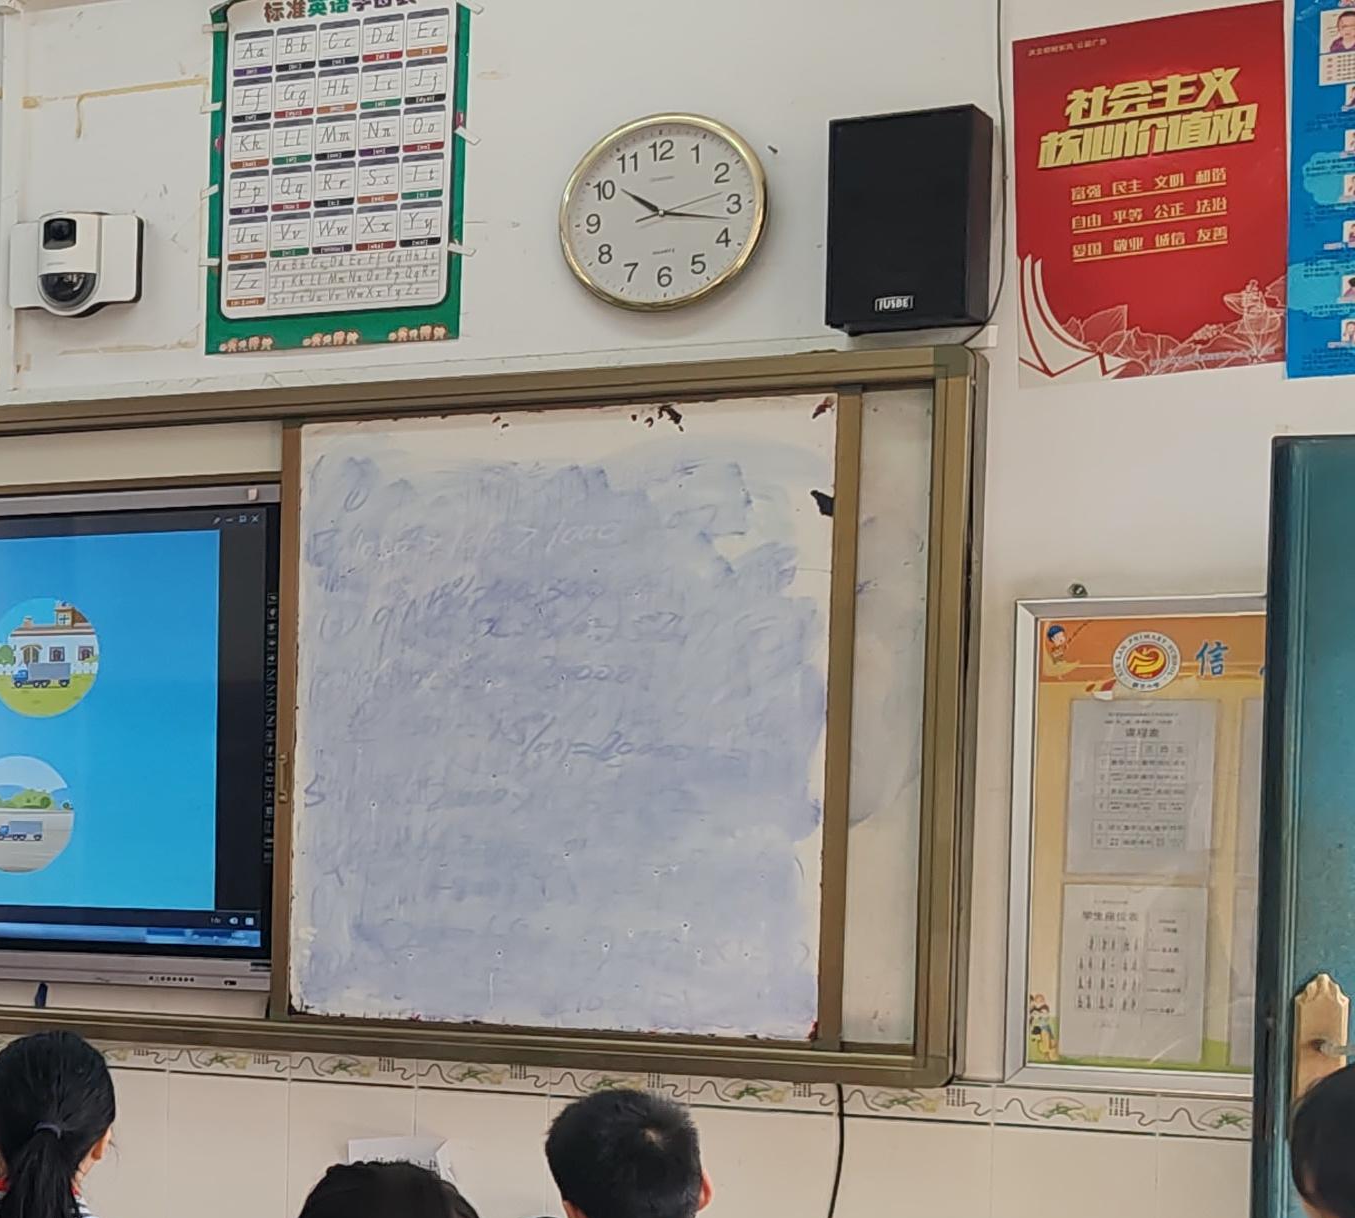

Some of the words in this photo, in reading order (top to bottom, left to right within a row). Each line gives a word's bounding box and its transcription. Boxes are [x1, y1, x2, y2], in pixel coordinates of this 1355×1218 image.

[1064, 68, 1240, 127] 社会主义
[1038, 104, 1258, 168] 核心价值观
[648, 139, 675, 161] 12
[691, 144, 701, 164] 1
[617, 152, 639, 174] 11
[714, 162, 731, 184] 2
[593, 180, 616, 201] 10
[1112, 179, 1142, 195] 民主
[1155, 173, 1184, 189] 文明
[726, 194, 742, 214] 3
[1072, 214, 1101, 229] 自由
[1113, 208, 1143, 223] 平等
[1154, 202, 1184, 218] 公正
[1196, 197, 1227, 213] 法治
[585, 214, 601, 234] 9
[715, 227, 731, 248] 4
[1155, 232, 1185, 247] 诚信
[1197, 226, 1227, 242] 友善
[598, 244, 613, 264] 8
[691, 254, 706, 275] 5
[623, 263, 639, 282] 7
[656, 266, 672, 287] 6
[1195, 641, 1228, 676] 信
